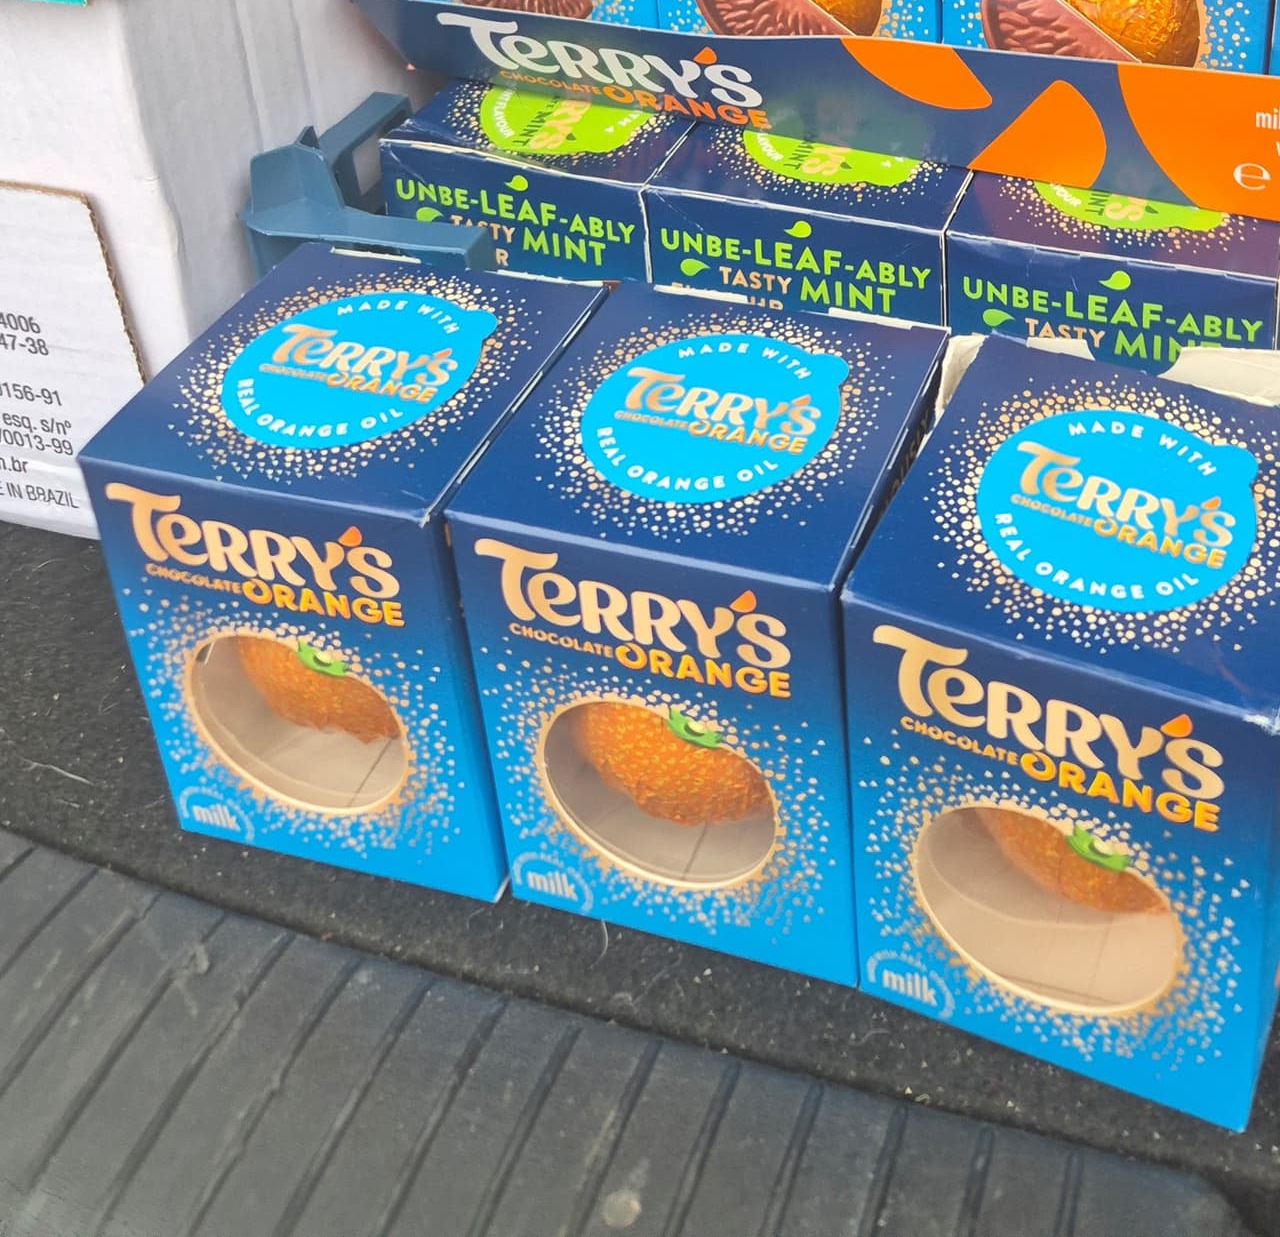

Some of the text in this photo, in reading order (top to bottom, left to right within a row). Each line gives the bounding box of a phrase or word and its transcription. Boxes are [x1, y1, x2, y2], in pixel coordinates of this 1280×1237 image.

[498, 70, 773, 131] CHOCOLATE ORANGE
[395, 178, 636, 245] UNBE-LEAF-ABLY
[521, 225, 607, 267] MINT
[660, 227, 932, 290] UNBE-LEAF-ABLY
[719, 265, 792, 295] TASTY
[800, 276, 896, 313] MINT
[962, 274, 1265, 344] UNBE-LEAF-ABLY
[336, 299, 461, 336] MADE WITH
[677, 342, 813, 380] MADE WITH
[235, 378, 404, 439] REAL ORANGE OIL
[327, 370, 438, 404] ORANGE
[3, 414, 37, 436] esq.
[687, 419, 808, 456] ORANGE
[1067, 420, 1218, 477] MADE WITH
[596, 426, 780, 493] REAL ORANGE OIL
[25, 485, 80, 510] BRAZIL
[993, 511, 1201, 601] REAL ORANGE OIL
[1092, 515, 1227, 569] ORANGE
[240, 578, 406, 628] ORANGE
[507, 622, 792, 700] CHOCOLATE ORANGE
[899, 714, 1222, 834] CHOCOLATE ORANGE
[193, 802, 242, 833] milk
[526, 867, 579, 904] milk
[882, 966, 939, 1008] milk
